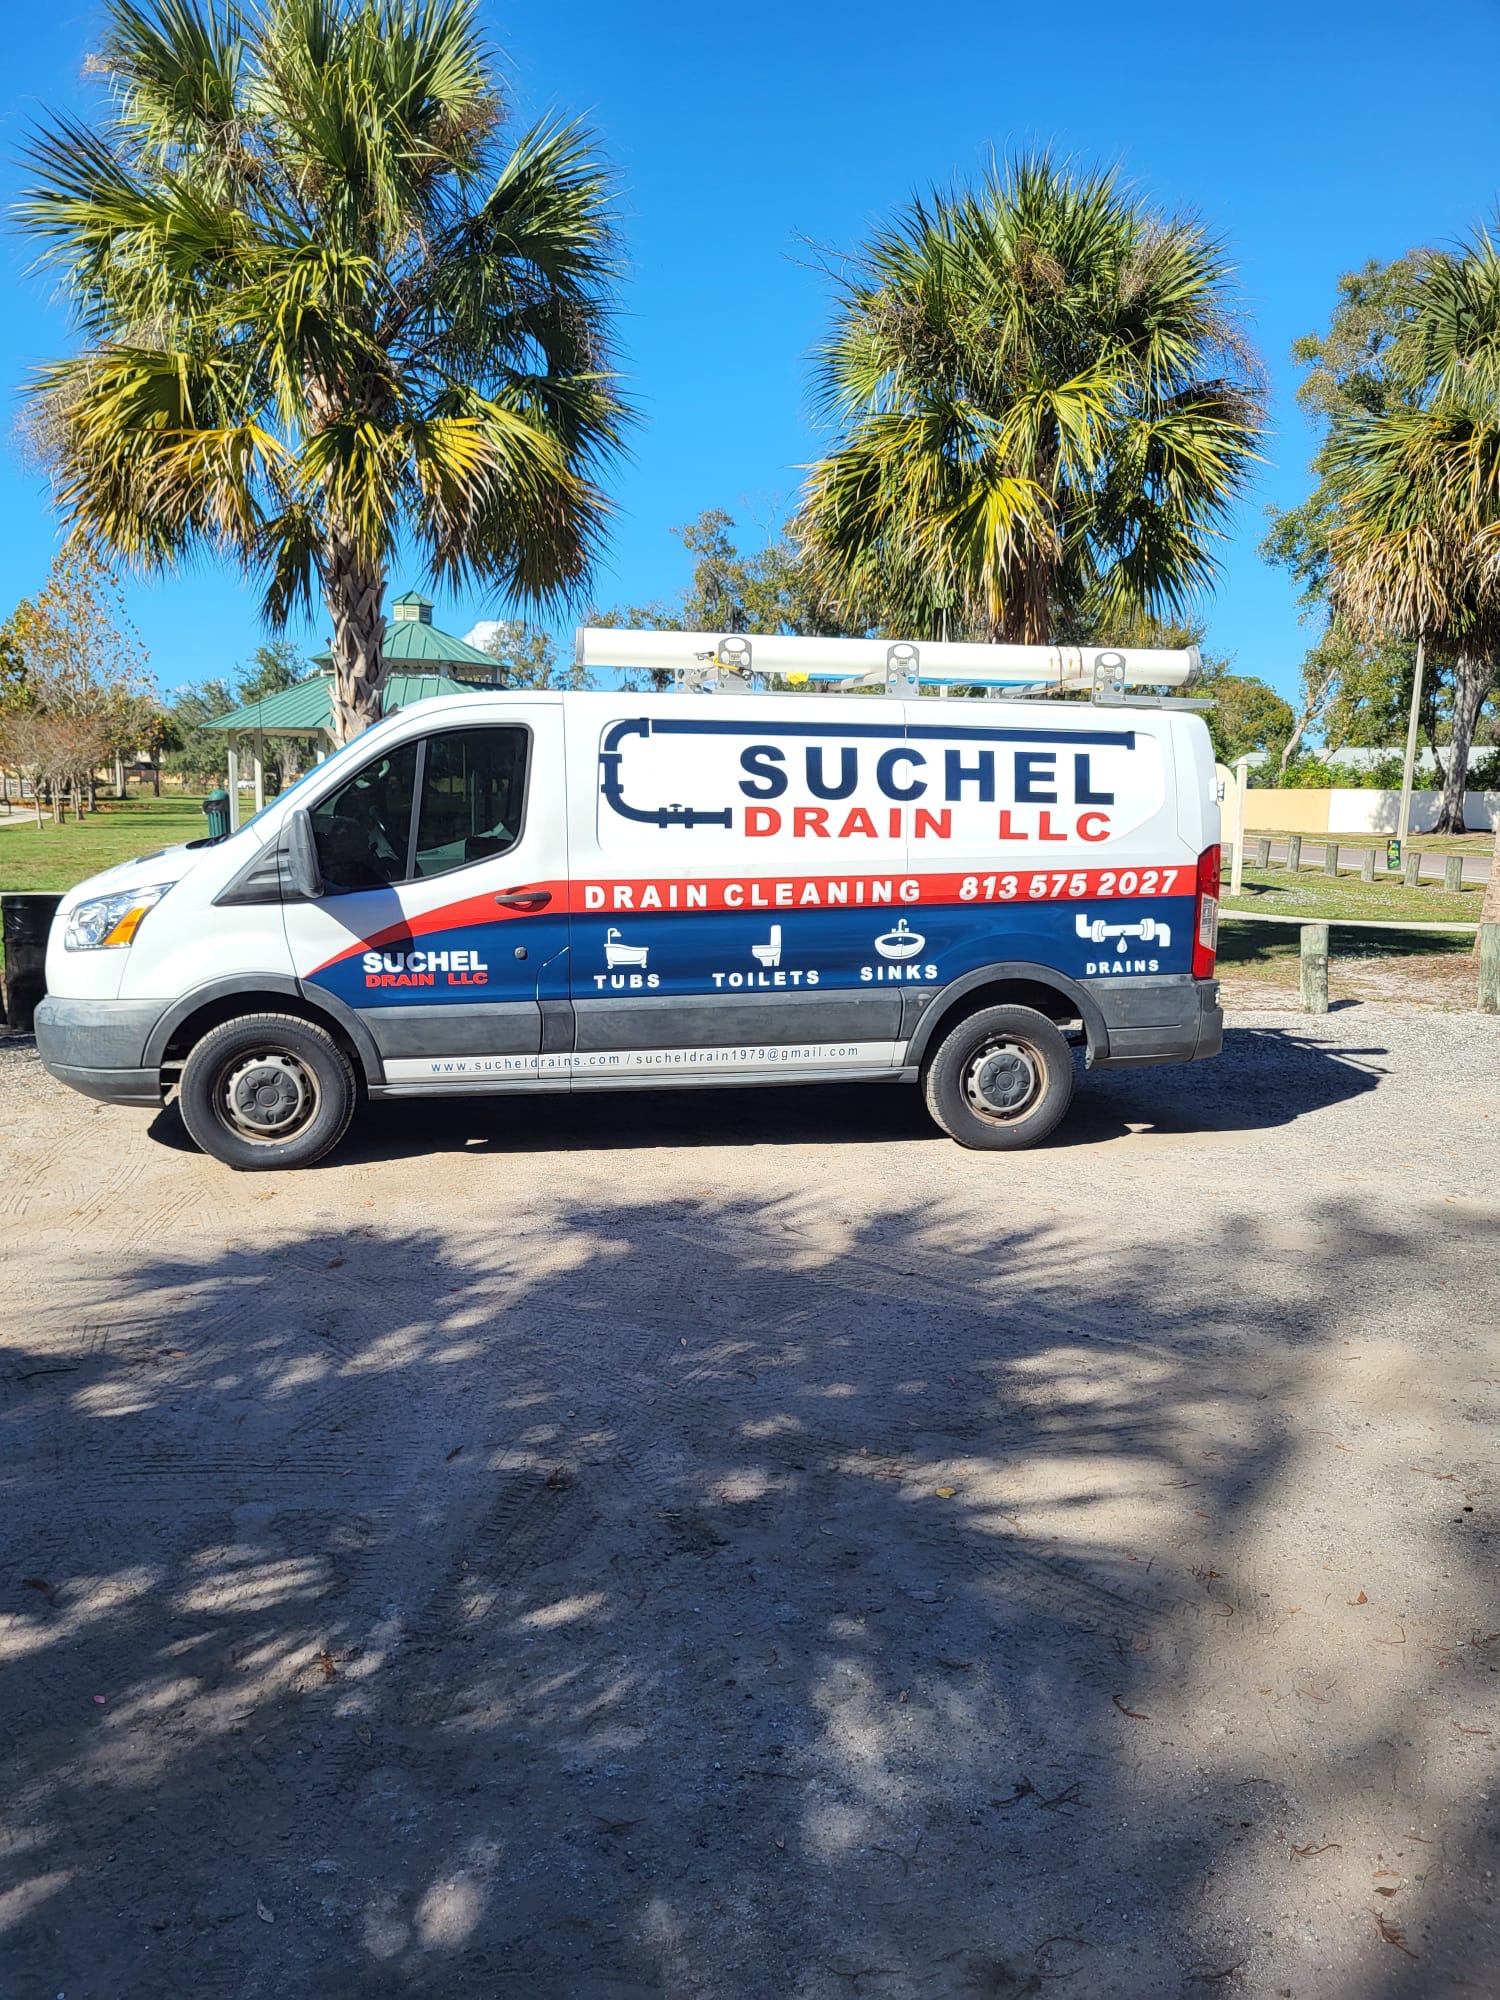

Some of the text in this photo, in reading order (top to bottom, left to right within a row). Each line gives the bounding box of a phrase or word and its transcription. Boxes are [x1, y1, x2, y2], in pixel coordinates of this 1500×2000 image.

[738, 744, 1115, 806] SUCHEL
[744, 806, 1111, 843] DRAIN LLC
[584, 868, 1179, 910] DRAIN CLEANING 813 575 2027
[362, 950, 488, 975] SUCHEL
[860, 964, 938, 982] SINKS
[1086, 959, 1159, 975] DRAINS
[365, 972, 489, 988] DRAIN LLC
[593, 973, 660, 990] TUBS
[711, 970, 820, 988] TOILETS
[431, 1054, 620, 1072] www.sucheldrains.com
[635, 1046, 859, 1065] sucheldrain1979@gmail.com
